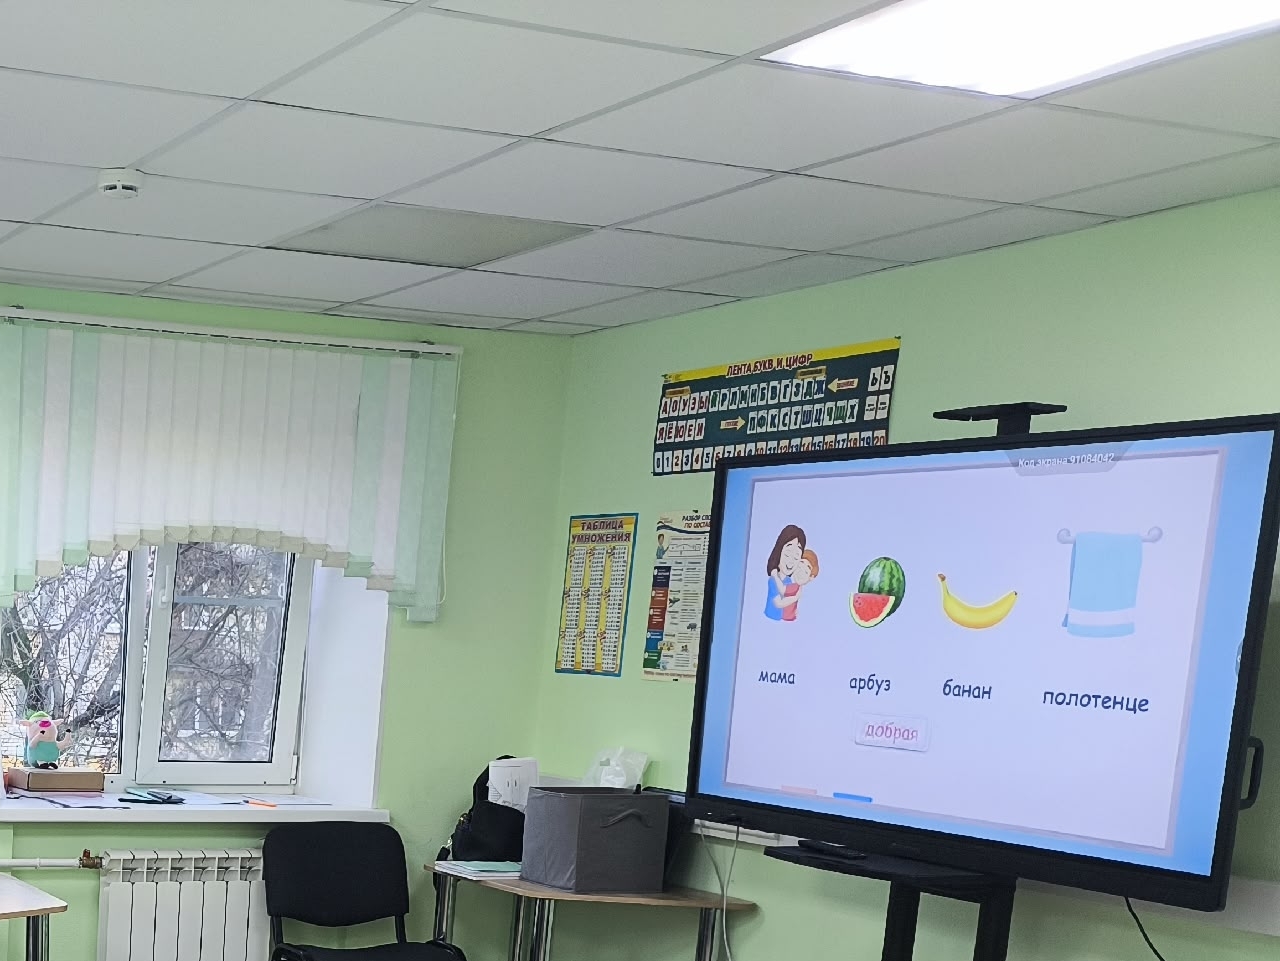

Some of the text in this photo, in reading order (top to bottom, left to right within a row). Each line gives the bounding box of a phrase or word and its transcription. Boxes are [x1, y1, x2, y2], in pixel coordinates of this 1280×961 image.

[727, 354, 813, 377] ЛЕНТА БУКВ И ЦИФР
[662, 402, 667, 414] А
[672, 401, 677, 413] О
[681, 397, 688, 411] У
[690, 396, 696, 407] Э
[699, 396, 708, 409] Ы
[658, 428, 664, 440] Я
[688, 424, 692, 435] Е
[674, 455, 679, 466] 2
[684, 455, 689, 466] 3
[694, 454, 699, 464] 4
[704, 452, 710, 463] 5
[837, 439, 846, 448] 17
[874, 436, 884, 445] 20
[1019, 458, 1035, 467] Код
[581, 520, 623, 530] ТАБЛИЦА
[571, 532, 631, 543] УМНОЖЕНИЯ
[758, 668, 796, 686] мама
[849, 674, 892, 695] арбуз
[943, 679, 993, 701] банан
[1043, 688, 1149, 714] полотенце
[865, 723, 919, 744] добрая
